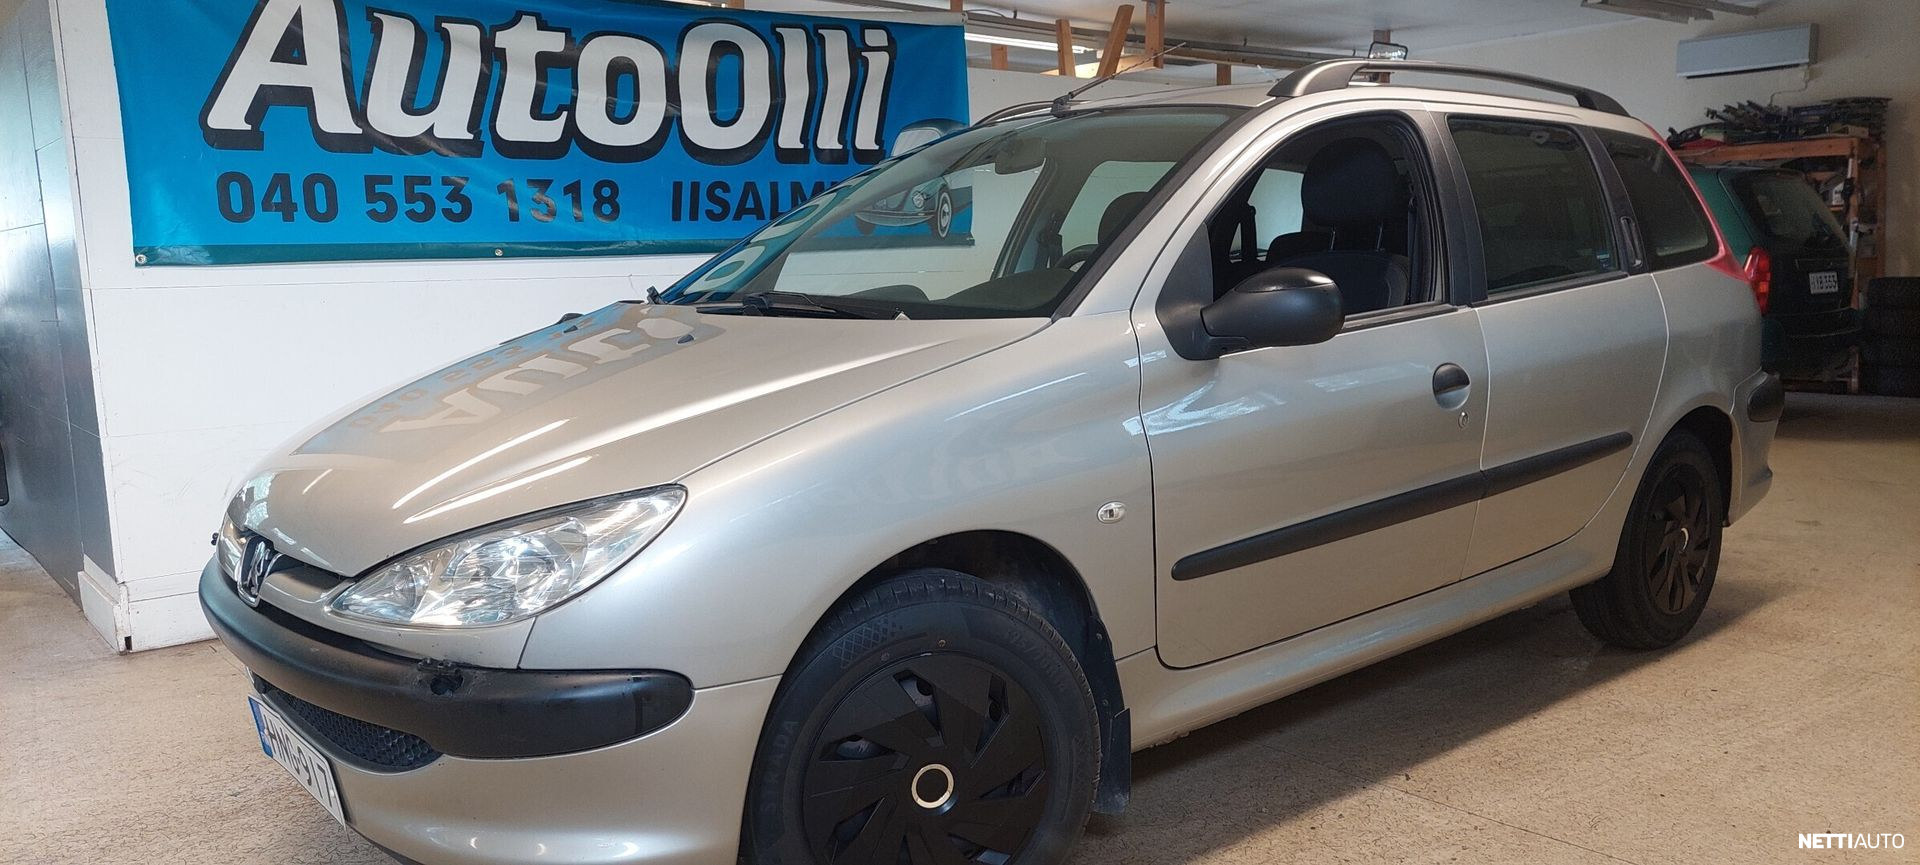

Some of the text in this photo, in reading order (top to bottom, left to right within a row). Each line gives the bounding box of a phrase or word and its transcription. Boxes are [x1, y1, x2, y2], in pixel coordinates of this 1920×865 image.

[199, 0, 896, 165] AutoOlli
[216, 171, 838, 223] 040 553 1318 IISALM
[263, 714, 333, 808] HNG-917
